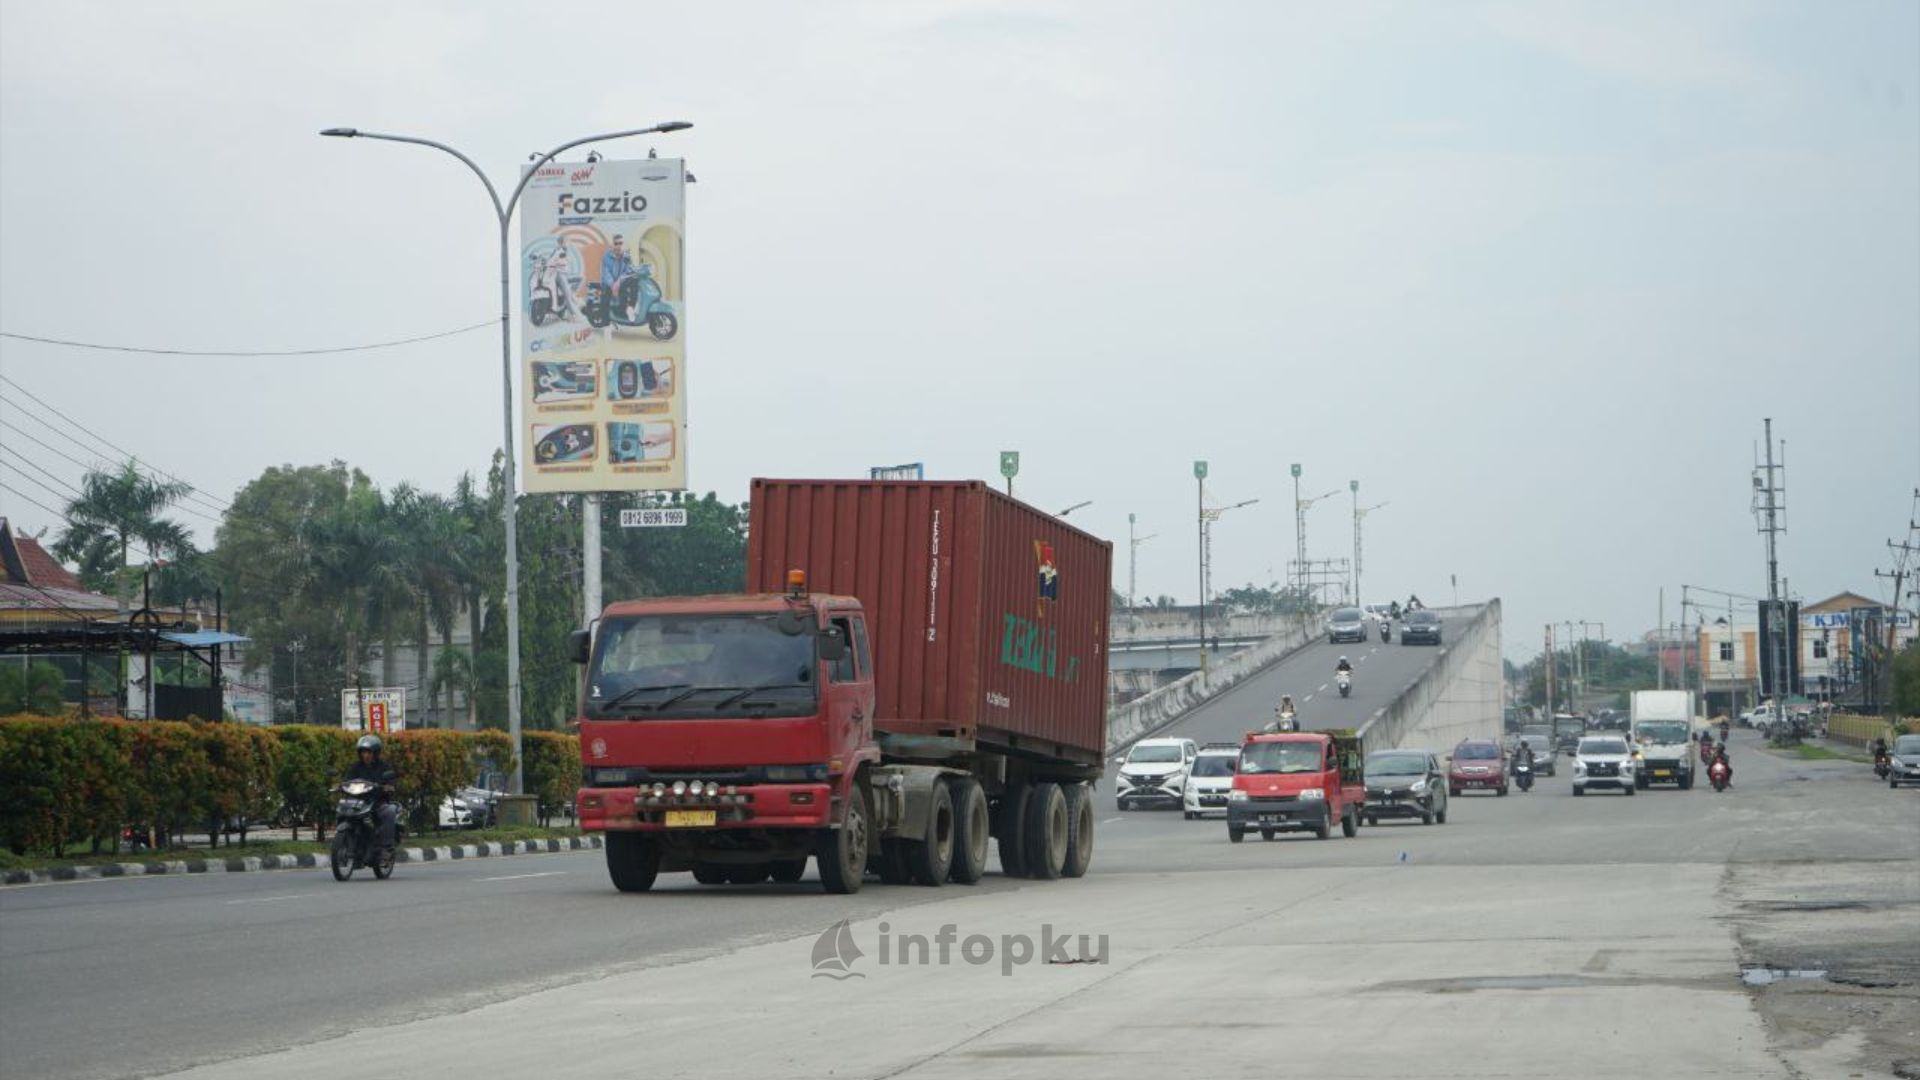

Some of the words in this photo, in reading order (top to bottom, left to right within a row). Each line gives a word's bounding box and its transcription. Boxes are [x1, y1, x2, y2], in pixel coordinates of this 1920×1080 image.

[559, 191, 648, 215] Fazzio
[623, 511, 642, 525] 0812
[927, 628, 937, 642] 2
